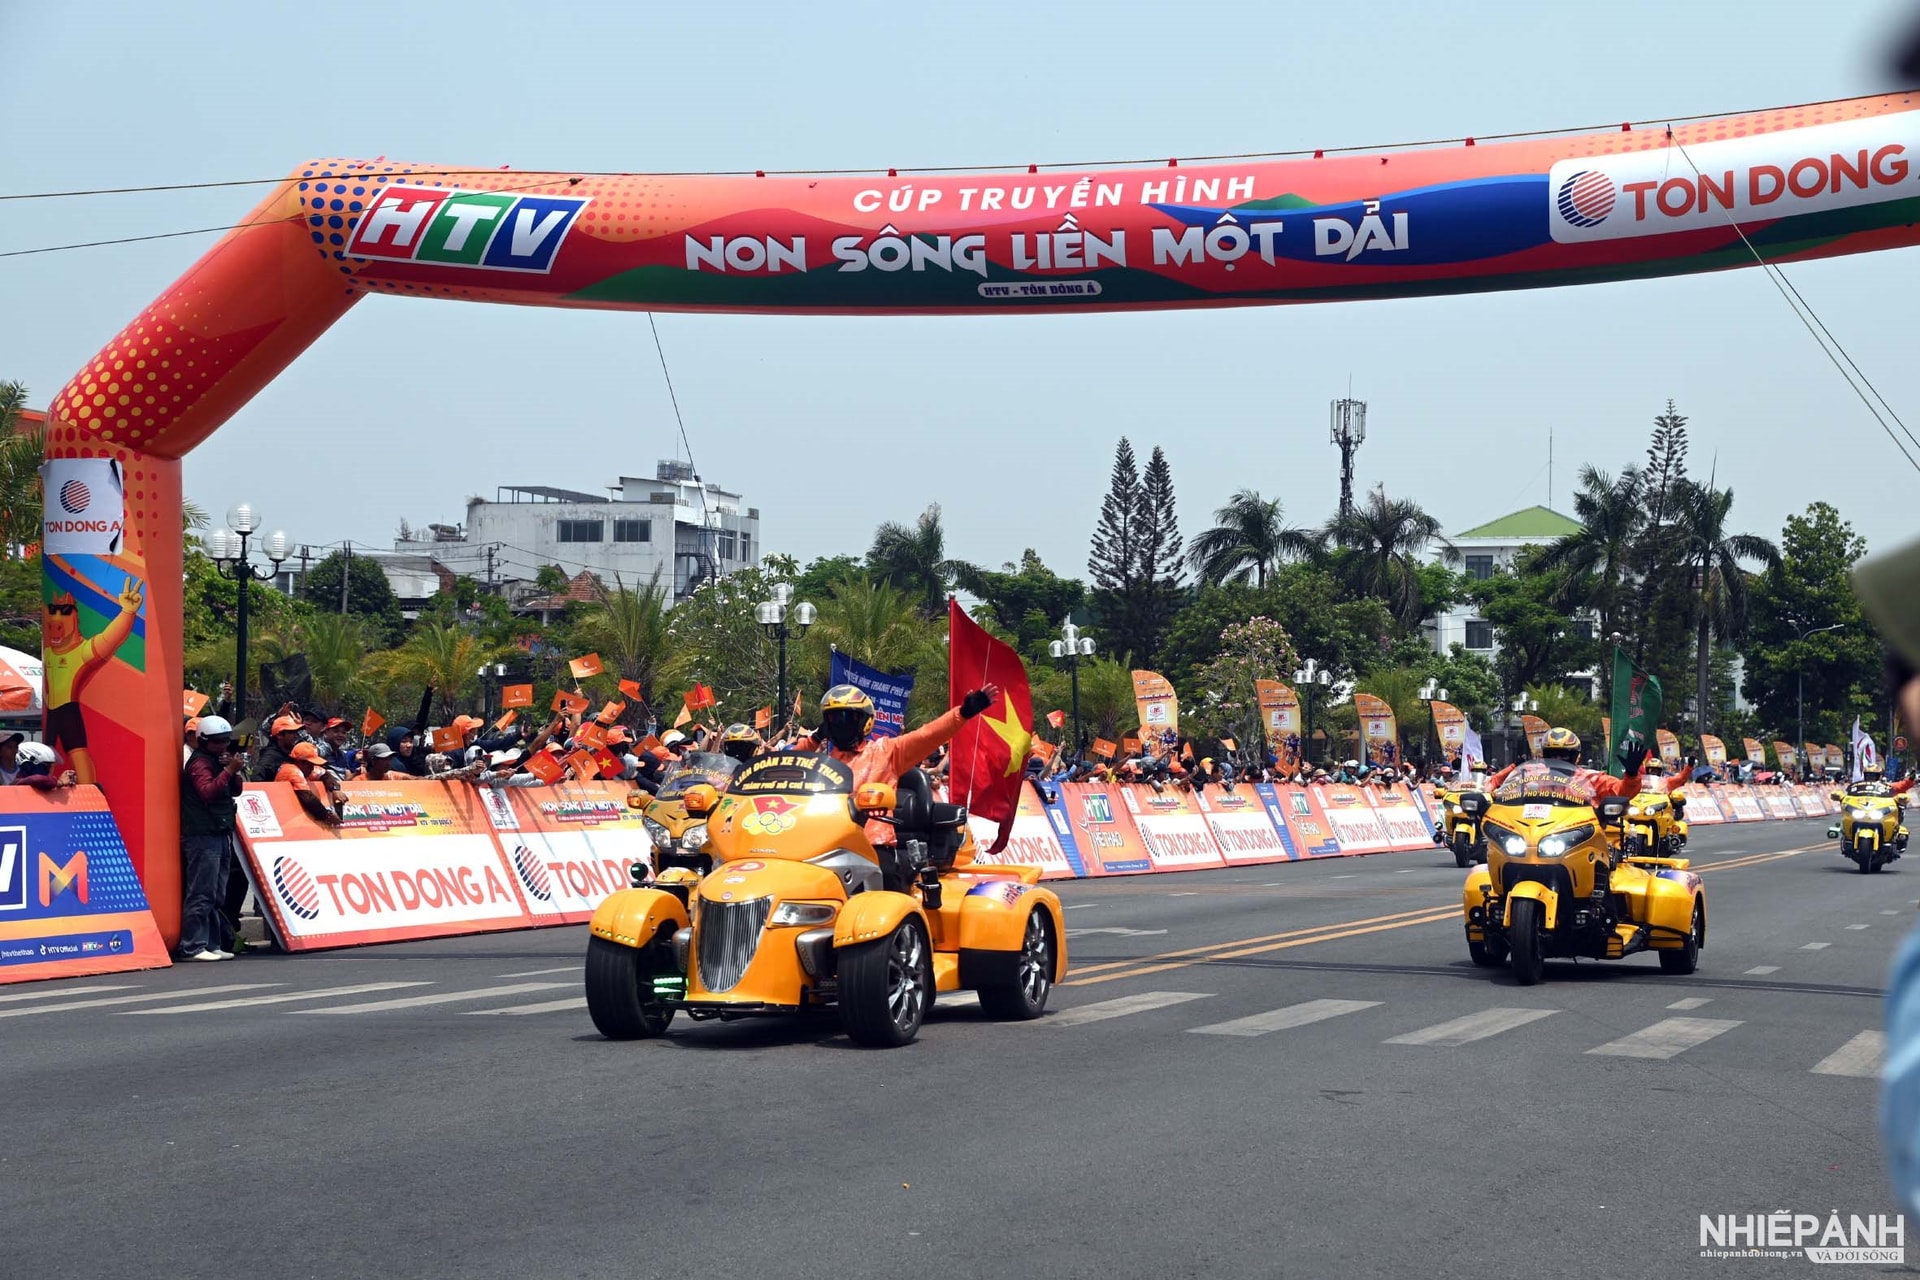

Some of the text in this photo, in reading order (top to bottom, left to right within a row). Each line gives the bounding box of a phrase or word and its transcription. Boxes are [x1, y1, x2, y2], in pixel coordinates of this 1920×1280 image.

[853, 175, 1255, 213] CÚP TRUYỀN HÌNH
[1623, 144, 1908, 221] TON DONG
[358, 196, 564, 257] HTV
[685, 200, 1409, 279] NON SÔNG LIỀN MỘT DẢI
[984, 286, 1010, 296] HTV
[1020, 284, 1047, 296] TÔN
[45, 520, 121, 533] TON DONG A
[780, 756, 794, 766] XE
[818, 763, 845, 785] THAO
[1084, 797, 1110, 820] HTV
[1011, 837, 1048, 864] DONG
[1048, 836, 1064, 861] A
[1155, 831, 1217, 856] TON DONG A
[1226, 828, 1281, 851] TON DONG A
[316, 865, 511, 916] TON DONG A
[547, 859, 616, 898] TON
